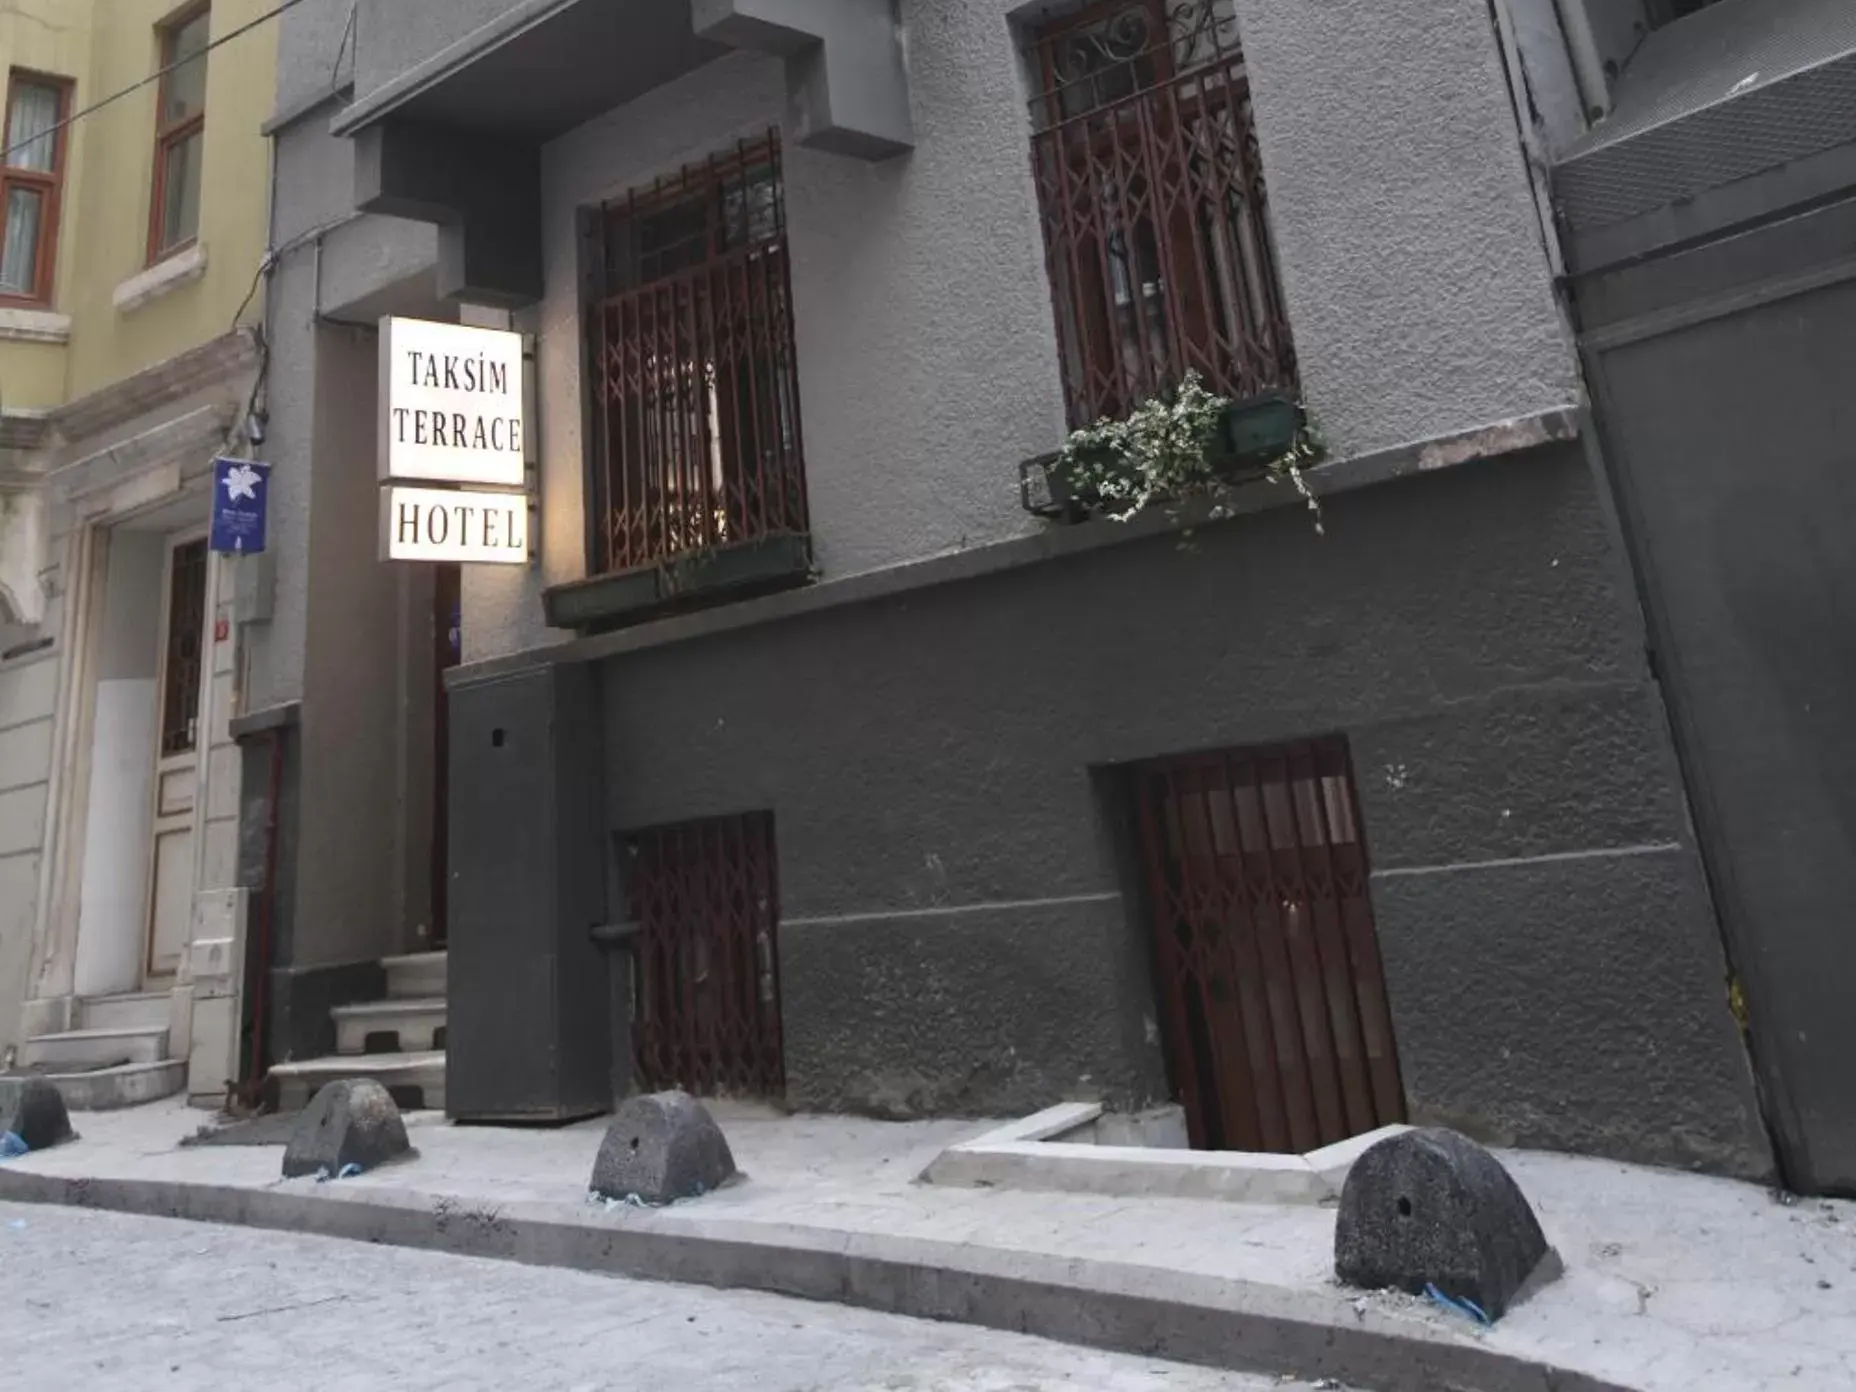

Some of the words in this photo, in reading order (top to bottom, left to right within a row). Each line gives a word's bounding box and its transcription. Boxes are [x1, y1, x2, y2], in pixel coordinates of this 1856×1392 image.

[408, 350, 507, 395] TAKSİM
[393, 408, 521, 452] TERRACE
[398, 502, 522, 548] HOTEL
